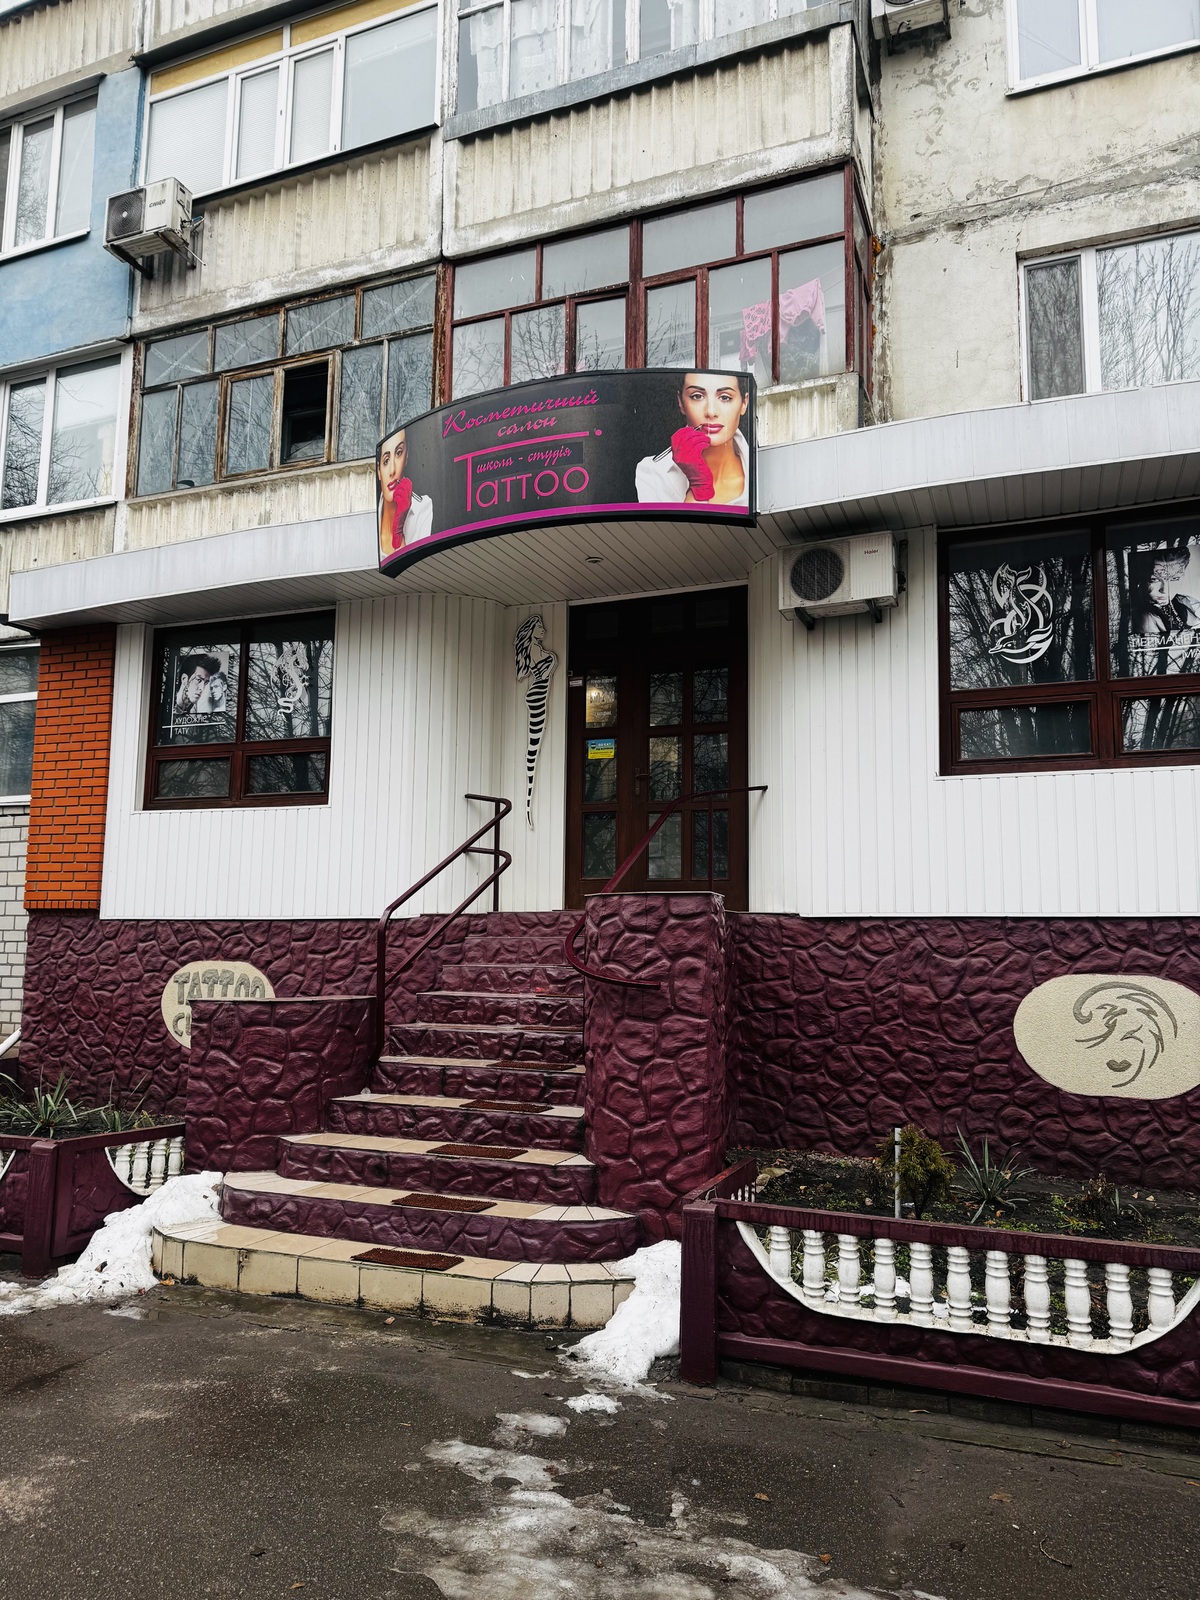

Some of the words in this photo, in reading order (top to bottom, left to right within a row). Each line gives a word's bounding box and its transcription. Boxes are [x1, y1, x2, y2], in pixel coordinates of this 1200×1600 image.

[442, 389, 600, 438] Косметичний
[497, 416, 558, 438] салон
[476, 456, 515, 474] школа
[527, 445, 573, 467] студія
[174, 727, 190, 735] ТАТУ
